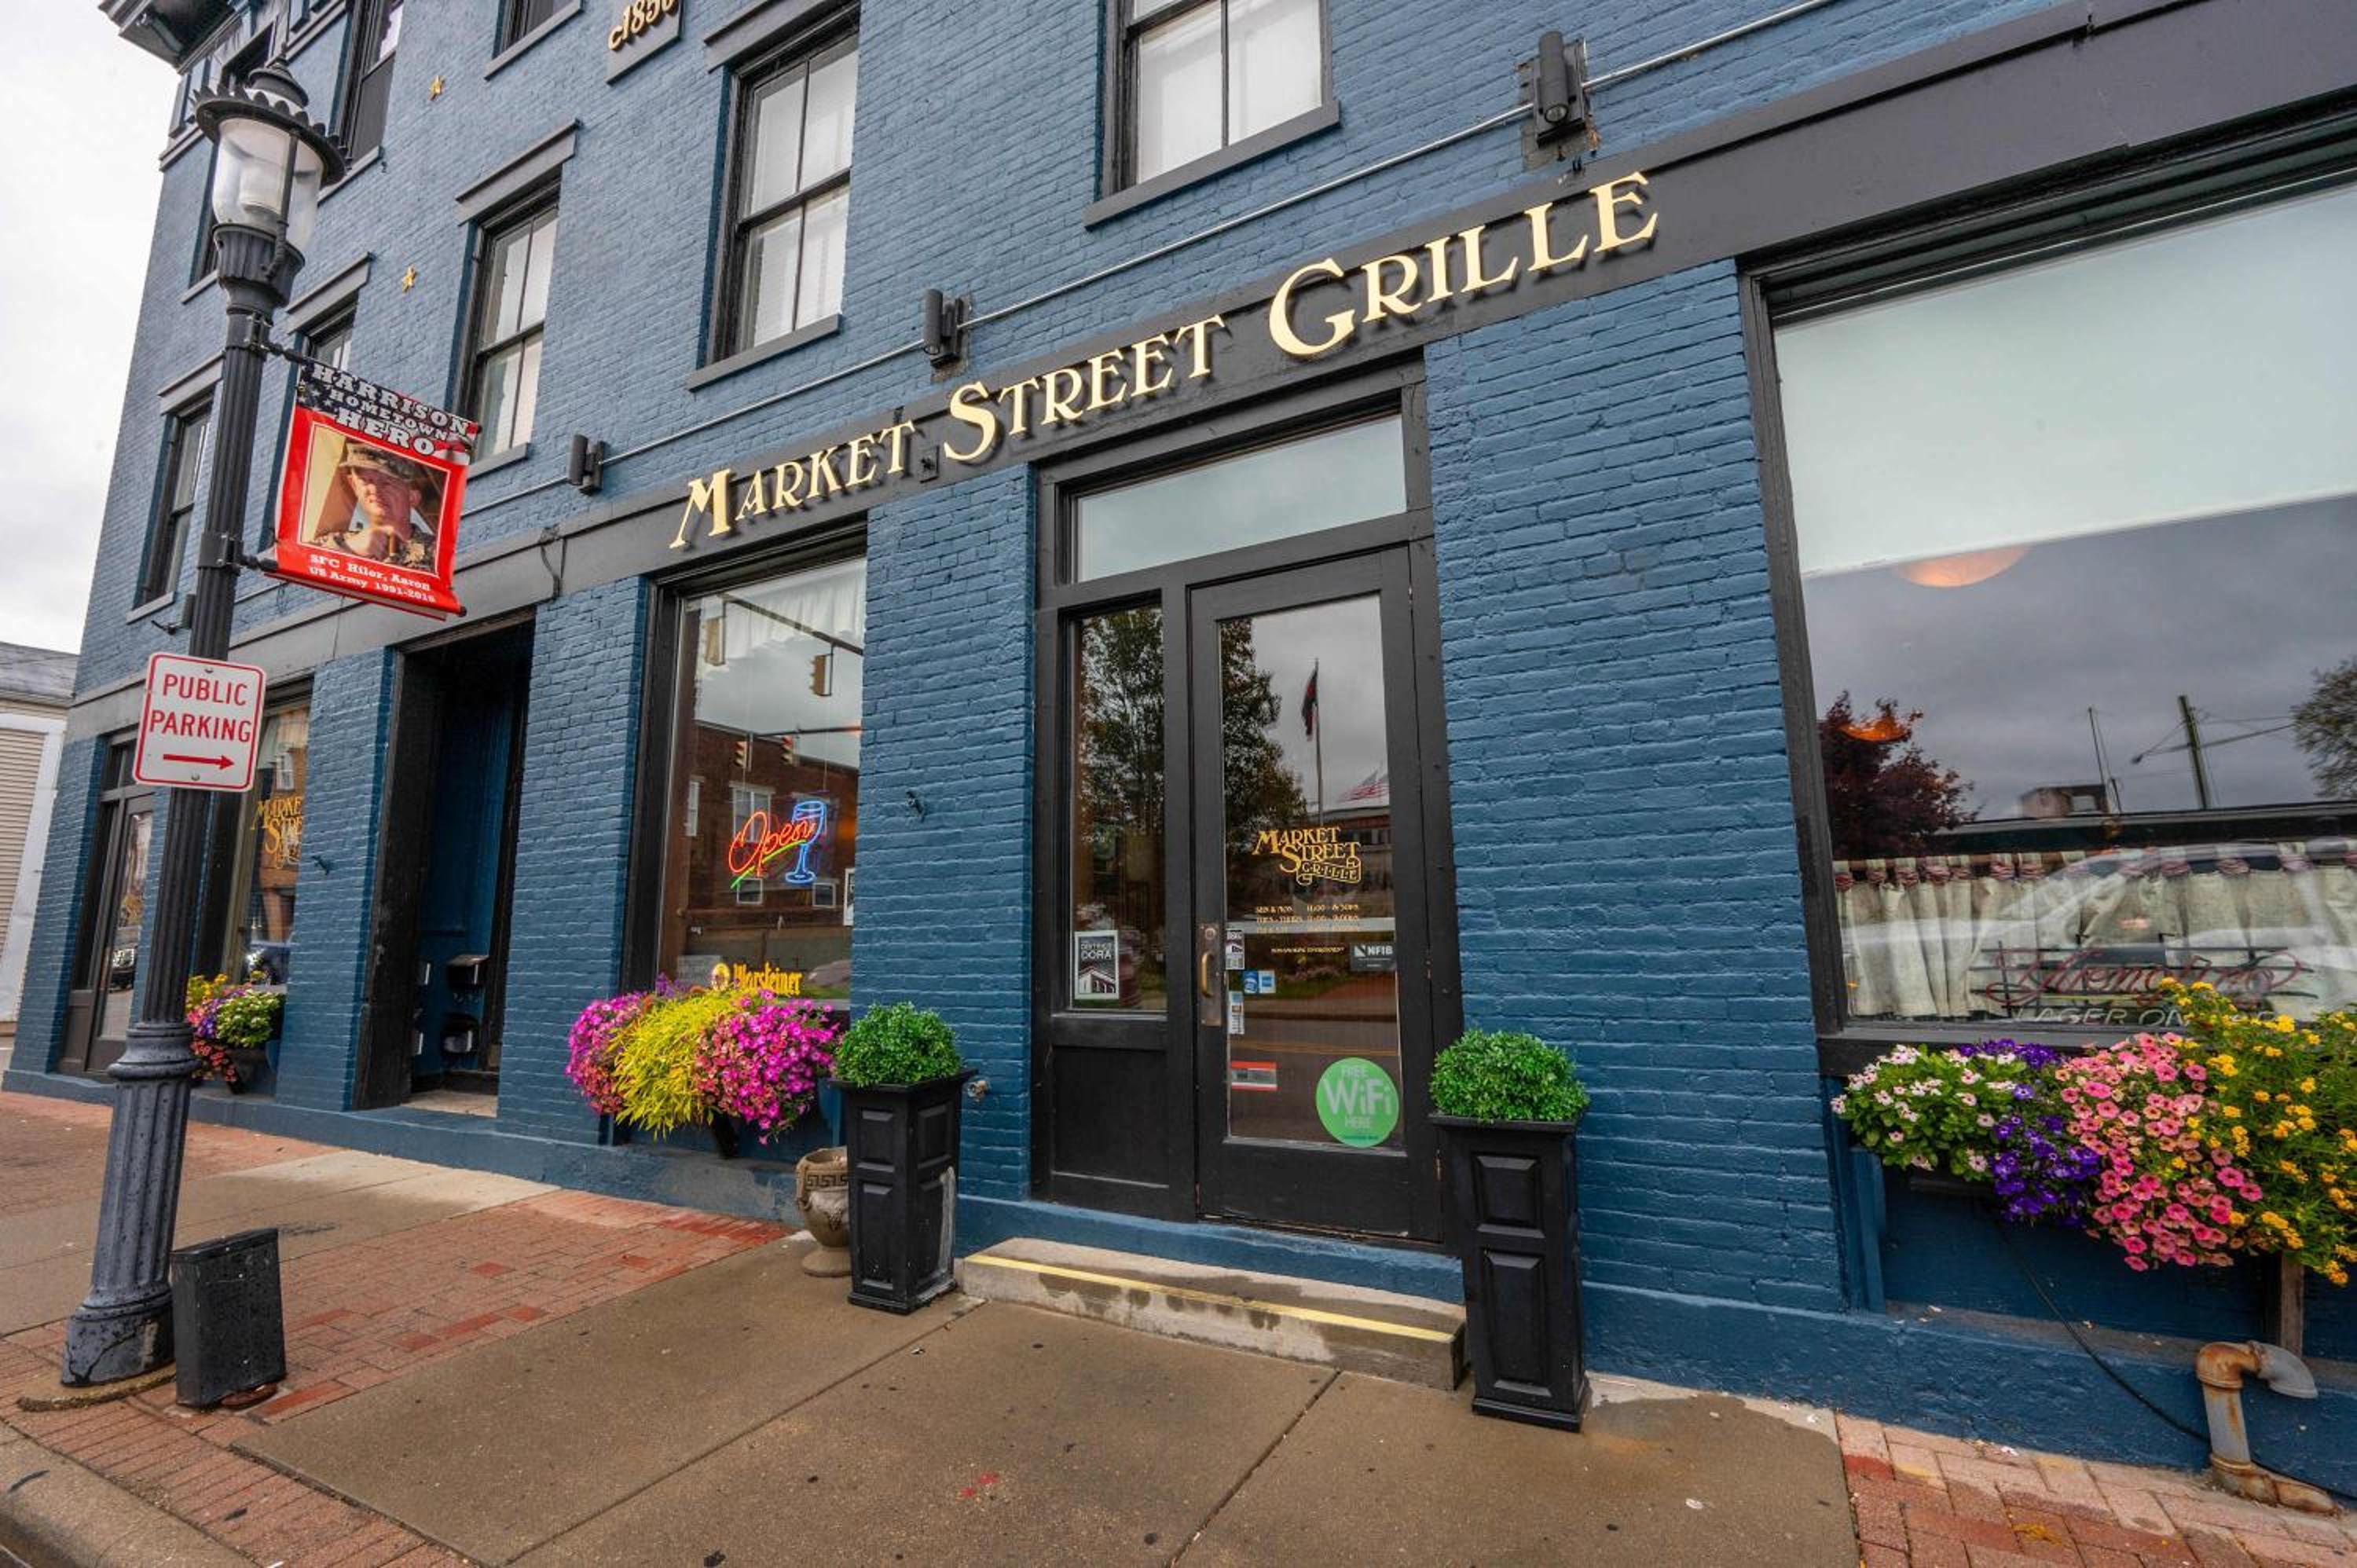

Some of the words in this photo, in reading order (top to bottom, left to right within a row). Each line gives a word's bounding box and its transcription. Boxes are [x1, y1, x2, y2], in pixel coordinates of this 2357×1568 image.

[608, 0, 674, 49] c185
[670, 419, 916, 549] MARKET
[944, 315, 1226, 462] STREET
[1269, 172, 1658, 355] GRILLE
[312, 362, 469, 436] HARRISON
[329, 389, 446, 441] HOMETOWN
[336, 406, 434, 455] HERO
[330, 572, 368, 588] Army
[163, 673, 247, 705] PUBLIC
[150, 709, 251, 742] PARKING
[250, 796, 302, 830] MARKE
[729, 811, 816, 877] Open
[1252, 826, 1340, 855] MARKET
[1280, 842, 1361, 873] STREET
[1368, 945, 1393, 955] NFIB
[2014, 1007, 2127, 1025] LAGER
[1322, 1079, 1391, 1116] WiFi
